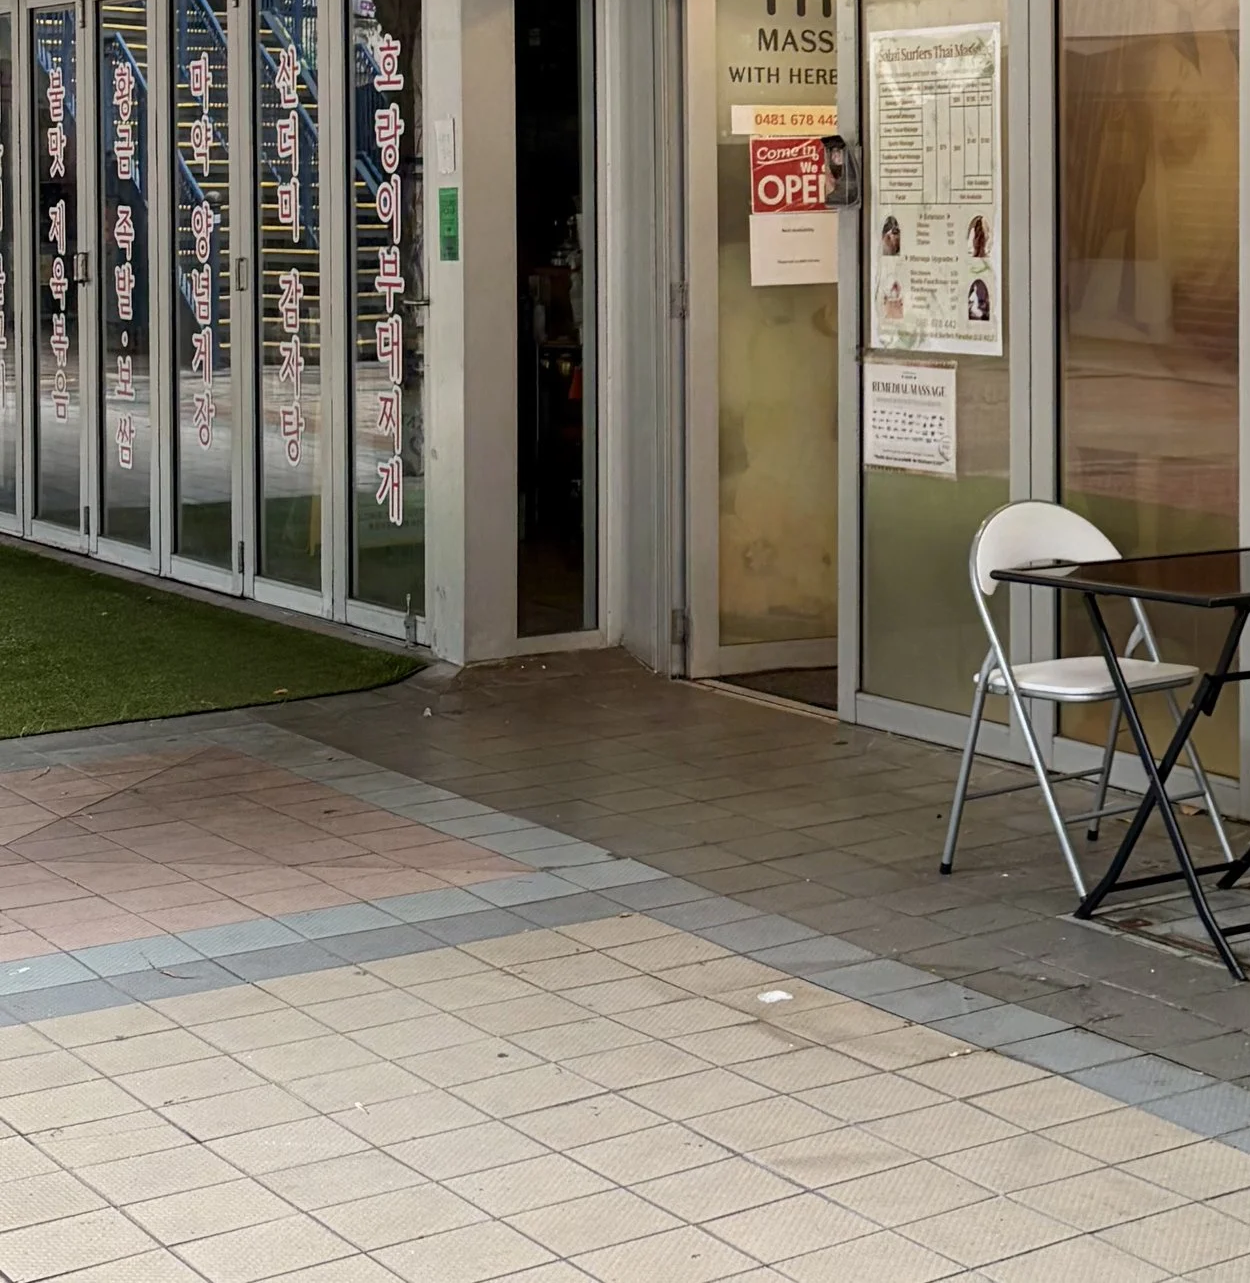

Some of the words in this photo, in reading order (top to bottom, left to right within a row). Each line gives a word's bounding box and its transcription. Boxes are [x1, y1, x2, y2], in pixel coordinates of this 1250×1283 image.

[758, 28, 837, 53] MASS
[729, 66, 780, 83] WITH
[755, 114, 786, 126] 0481
[790, 114, 814, 126] 678
[756, 146, 800, 161] Come
